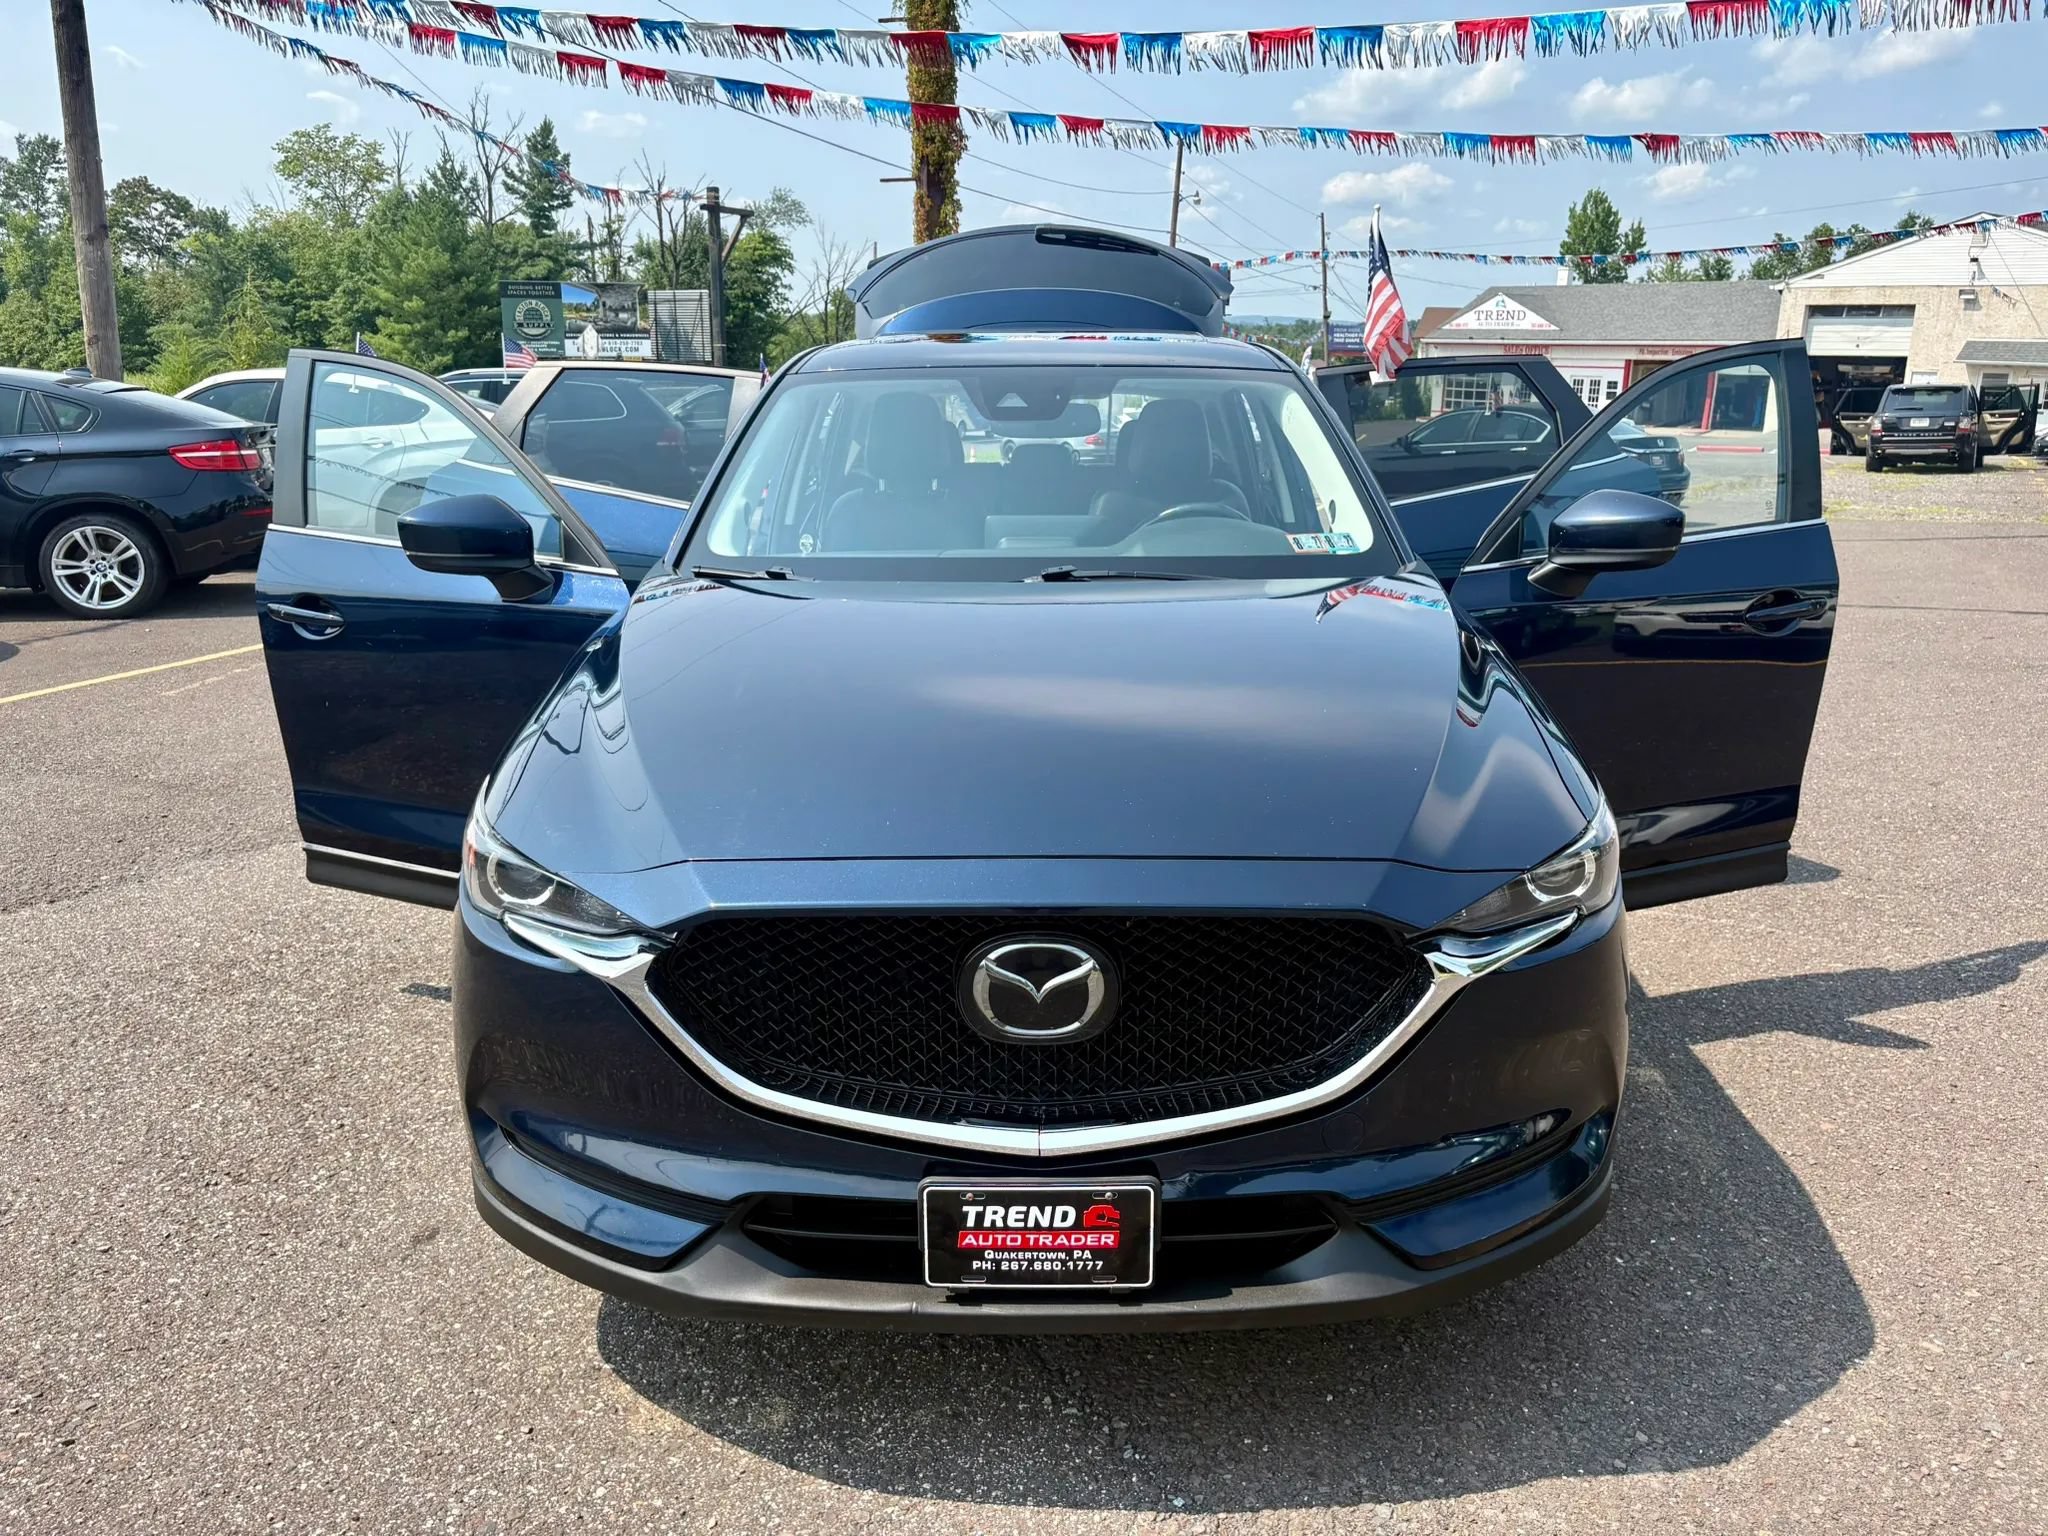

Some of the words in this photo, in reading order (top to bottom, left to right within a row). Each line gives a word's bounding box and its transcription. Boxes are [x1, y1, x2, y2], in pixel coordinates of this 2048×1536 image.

[534, 301, 549, 318] BLOCK
[1474, 309, 1527, 321] TREND
[962, 1205, 1077, 1228] TREND
[961, 1234, 1022, 1246] AUTO
[1025, 1234, 1115, 1246] TRADER
[1073, 1250, 1092, 1260] PA
[972, 1261, 996, 1270] PH:
[1000, 1260, 1104, 1271] 267.680.1777
